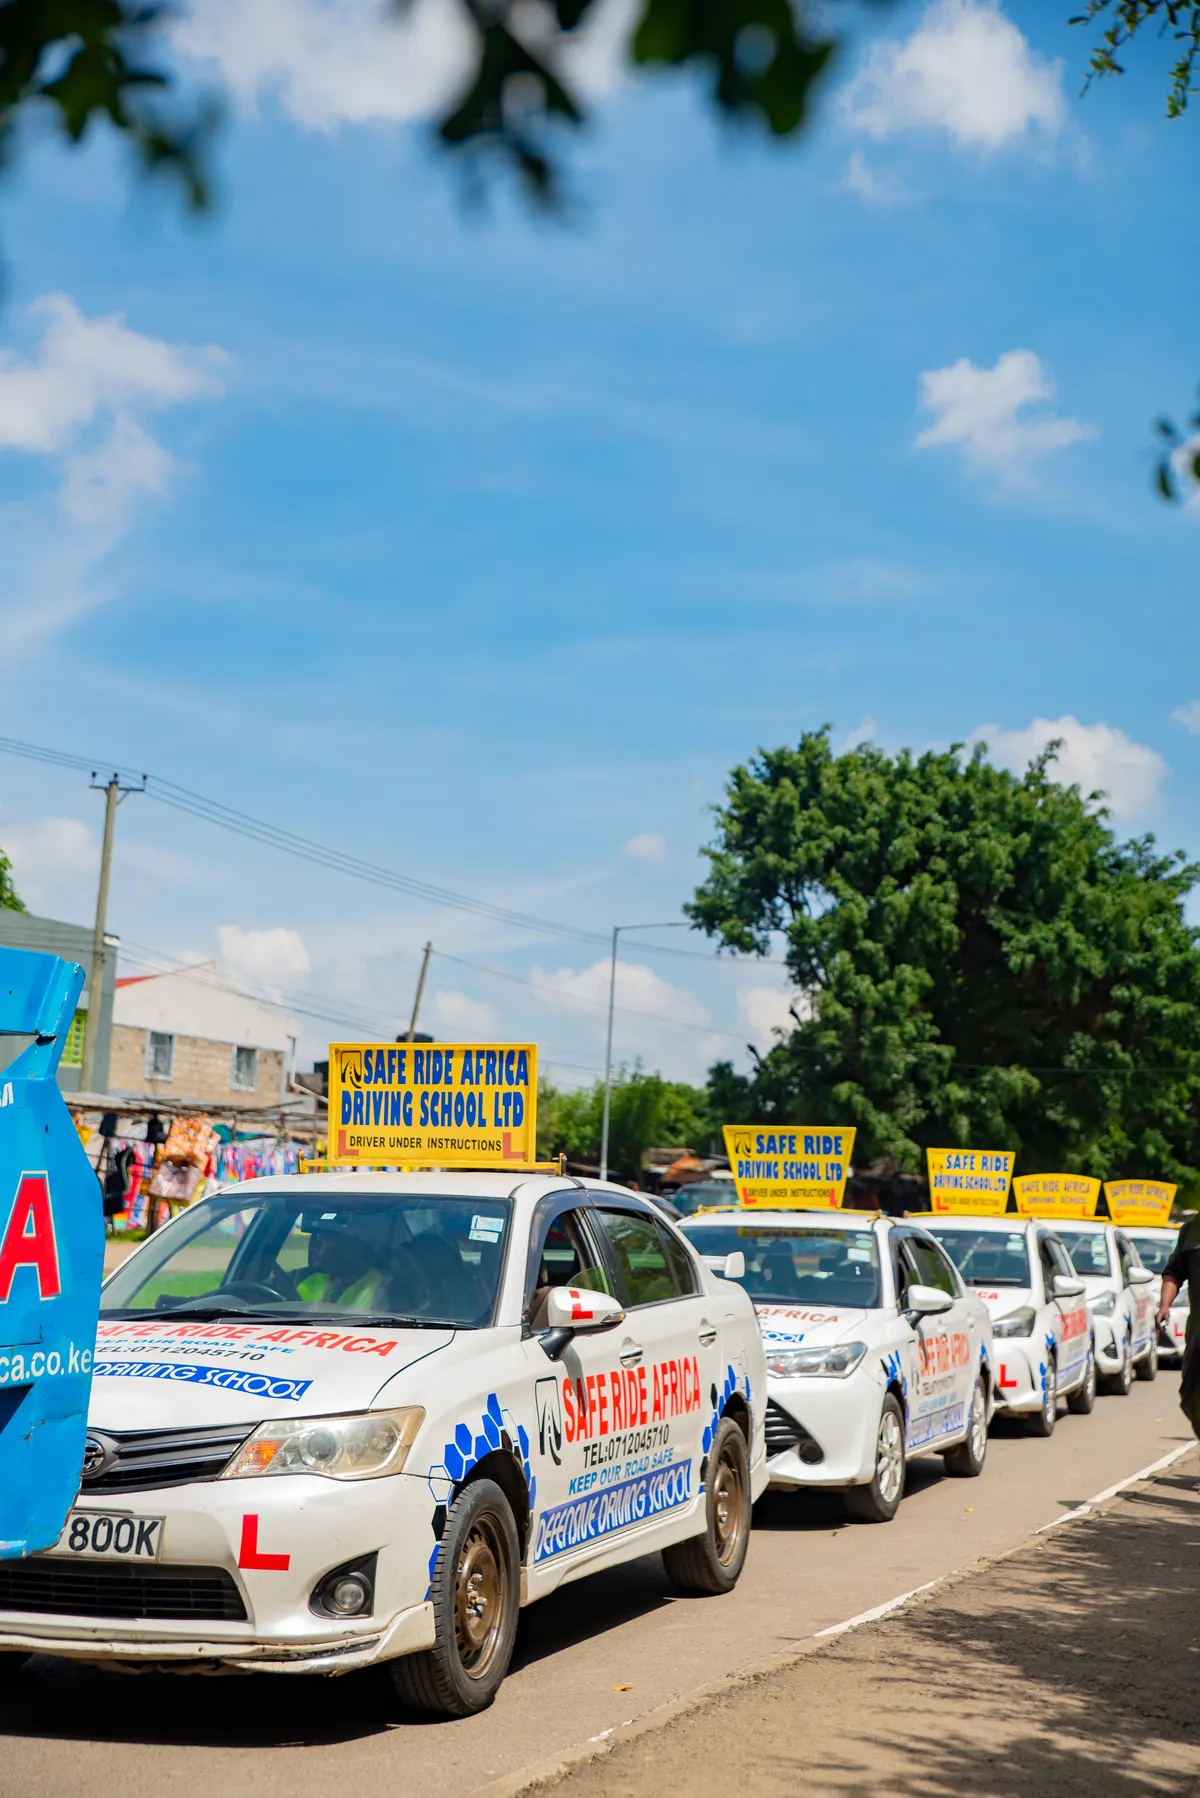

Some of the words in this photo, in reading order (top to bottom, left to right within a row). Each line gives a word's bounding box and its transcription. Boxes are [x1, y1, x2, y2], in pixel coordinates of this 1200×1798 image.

[363, 1050, 407, 1085] SAFE
[413, 1050, 455, 1085] RIDE
[460, 1050, 529, 1086] AFRICA
[341, 1090, 413, 1126] DRIVING
[419, 1091, 486, 1127] SCHOOL
[494, 1091, 524, 1127] LTD
[338, 1130, 359, 1156] L
[349, 1136, 385, 1148] DRIVER
[389, 1137, 422, 1149] UNDER
[427, 1138, 502, 1152] INSTRUCTIONS
[502, 1132, 526, 1158] L
[756, 1134, 797, 1155] SAFE
[804, 1135, 843, 1155] RIDE
[738, 1160, 779, 1179] DRIVING
[783, 1161, 821, 1181] SCHOOL
[825, 1162, 843, 1181] LTD
[946, 1154, 976, 1170] SAFE
[981, 1156, 1009, 1172] RIDE
[748, 1188, 768, 1197] DRIVER
[770, 1188, 787, 1198] UNDER
[790, 1188, 830, 1198] INSTRUCTIONS
[934, 1175, 963, 1189] DRIVING
[965, 1176, 992, 1190] SCHOOL
[1021, 1181, 1040, 1193] SAFE
[1043, 1180, 1060, 1192] RIDE
[1063, 1181, 1091, 1194] AFRICA
[1129, 1183, 1143, 1195] RIDE
[1146, 1185, 1170, 1201] AFRICA
[758, 1308, 839, 1322] AFRICA
[97, 1324, 172, 1337] AFE
[162, 1325, 256, 1340] RIDE
[252, 1329, 399, 1357] AFRICA
[243, 1344, 297, 1354] SAFE
[93, 1363, 198, 1380] DRIVING
[198, 1370, 306, 1401] SCHOOL
[999, 1363, 1017, 1387] L
[562, 1373, 609, 1443] SAFE
[610, 1367, 648, 1432] RIDE
[652, 1356, 701, 1423] AFRICA
[583, 1424, 670, 1468] TEL:0712045710
[568, 1471, 598, 1496] KEEP
[600, 1465, 622, 1486] OUR
[624, 1456, 650, 1479] ROAD
[651, 1448, 675, 1470] SAFE
[535, 1497, 598, 1561] DEFENSIVE
[598, 1479, 646, 1534] DRIVING
[649, 1465, 692, 1514] SCHOOL
[68, 1516, 160, 1557] 800K
[238, 1514, 291, 1571] L
